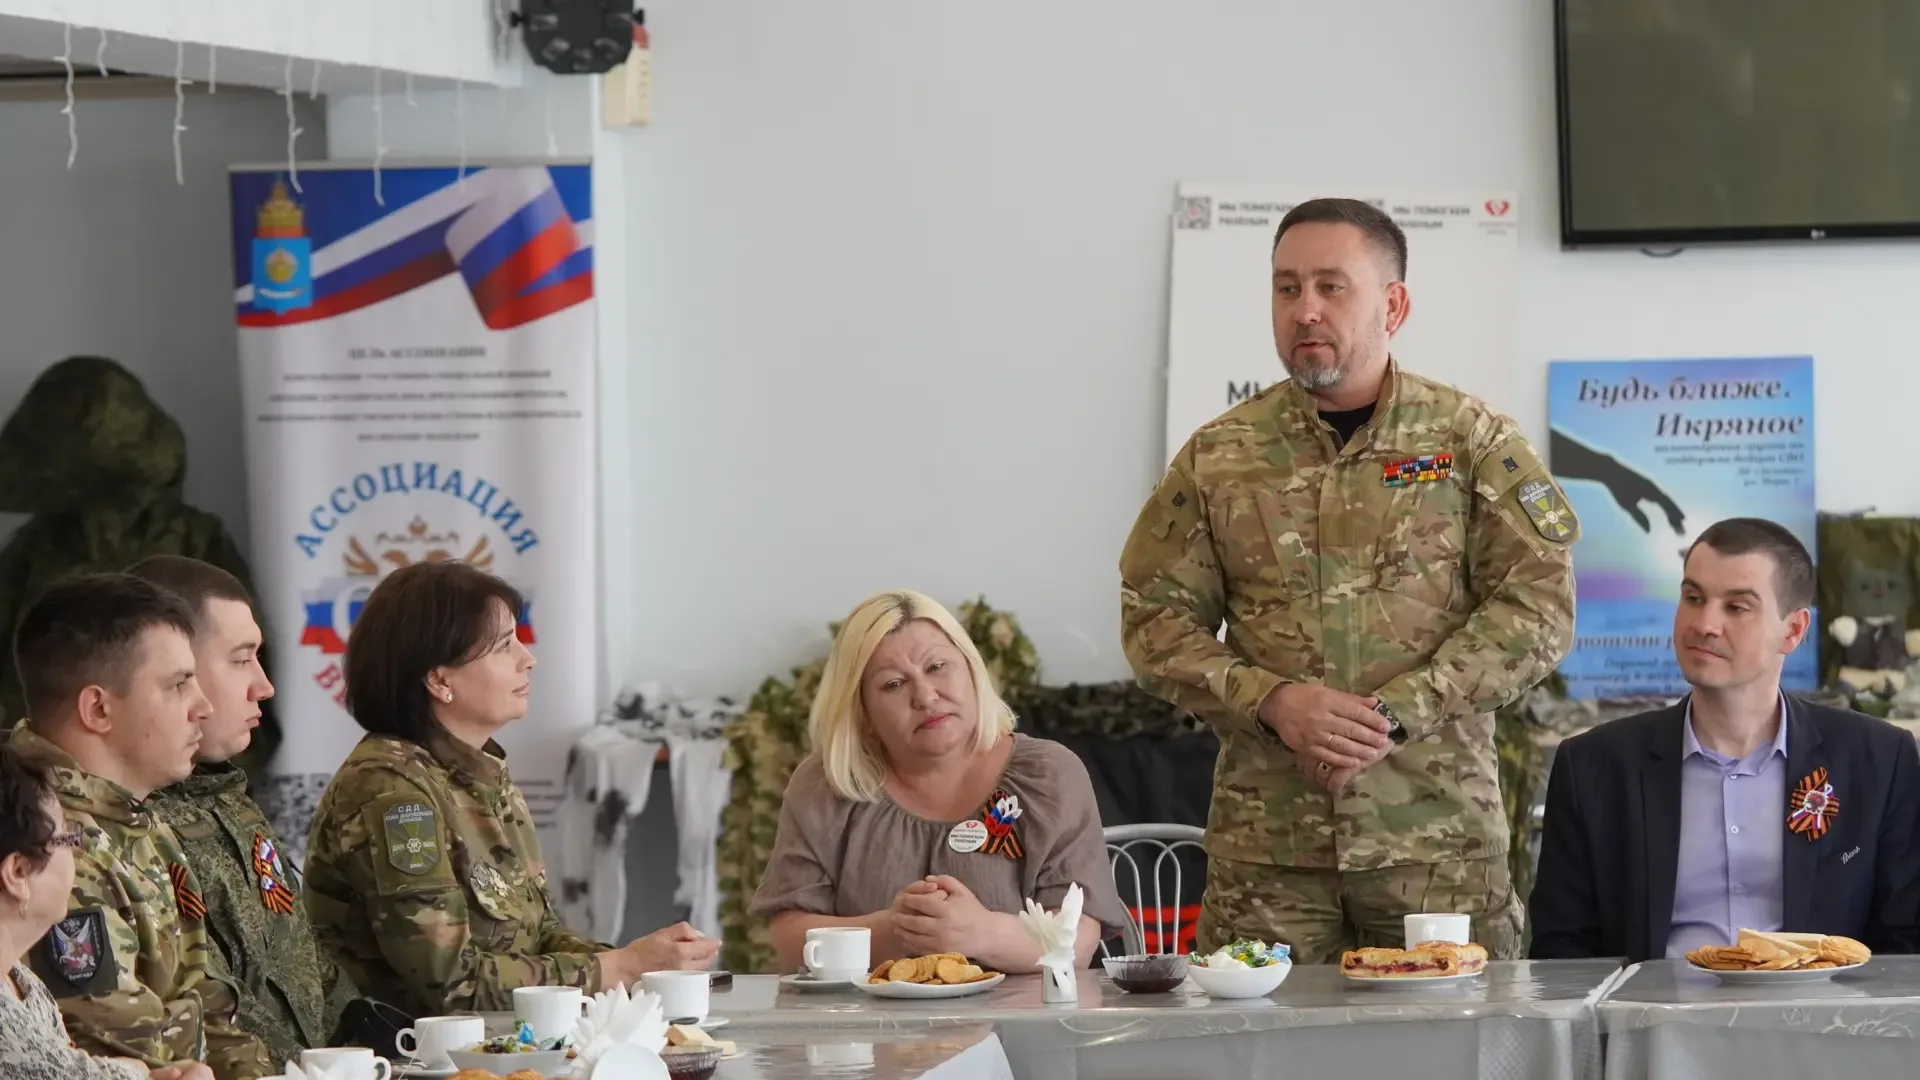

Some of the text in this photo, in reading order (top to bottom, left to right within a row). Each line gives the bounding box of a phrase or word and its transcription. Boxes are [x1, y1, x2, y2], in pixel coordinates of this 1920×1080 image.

[1228, 381, 1259, 405] М
[1578, 376, 1790, 409] Будь ближе.
[1655, 412, 1804, 442] Икряное
[294, 462, 540, 560] АССОЦИАЦИЯ
